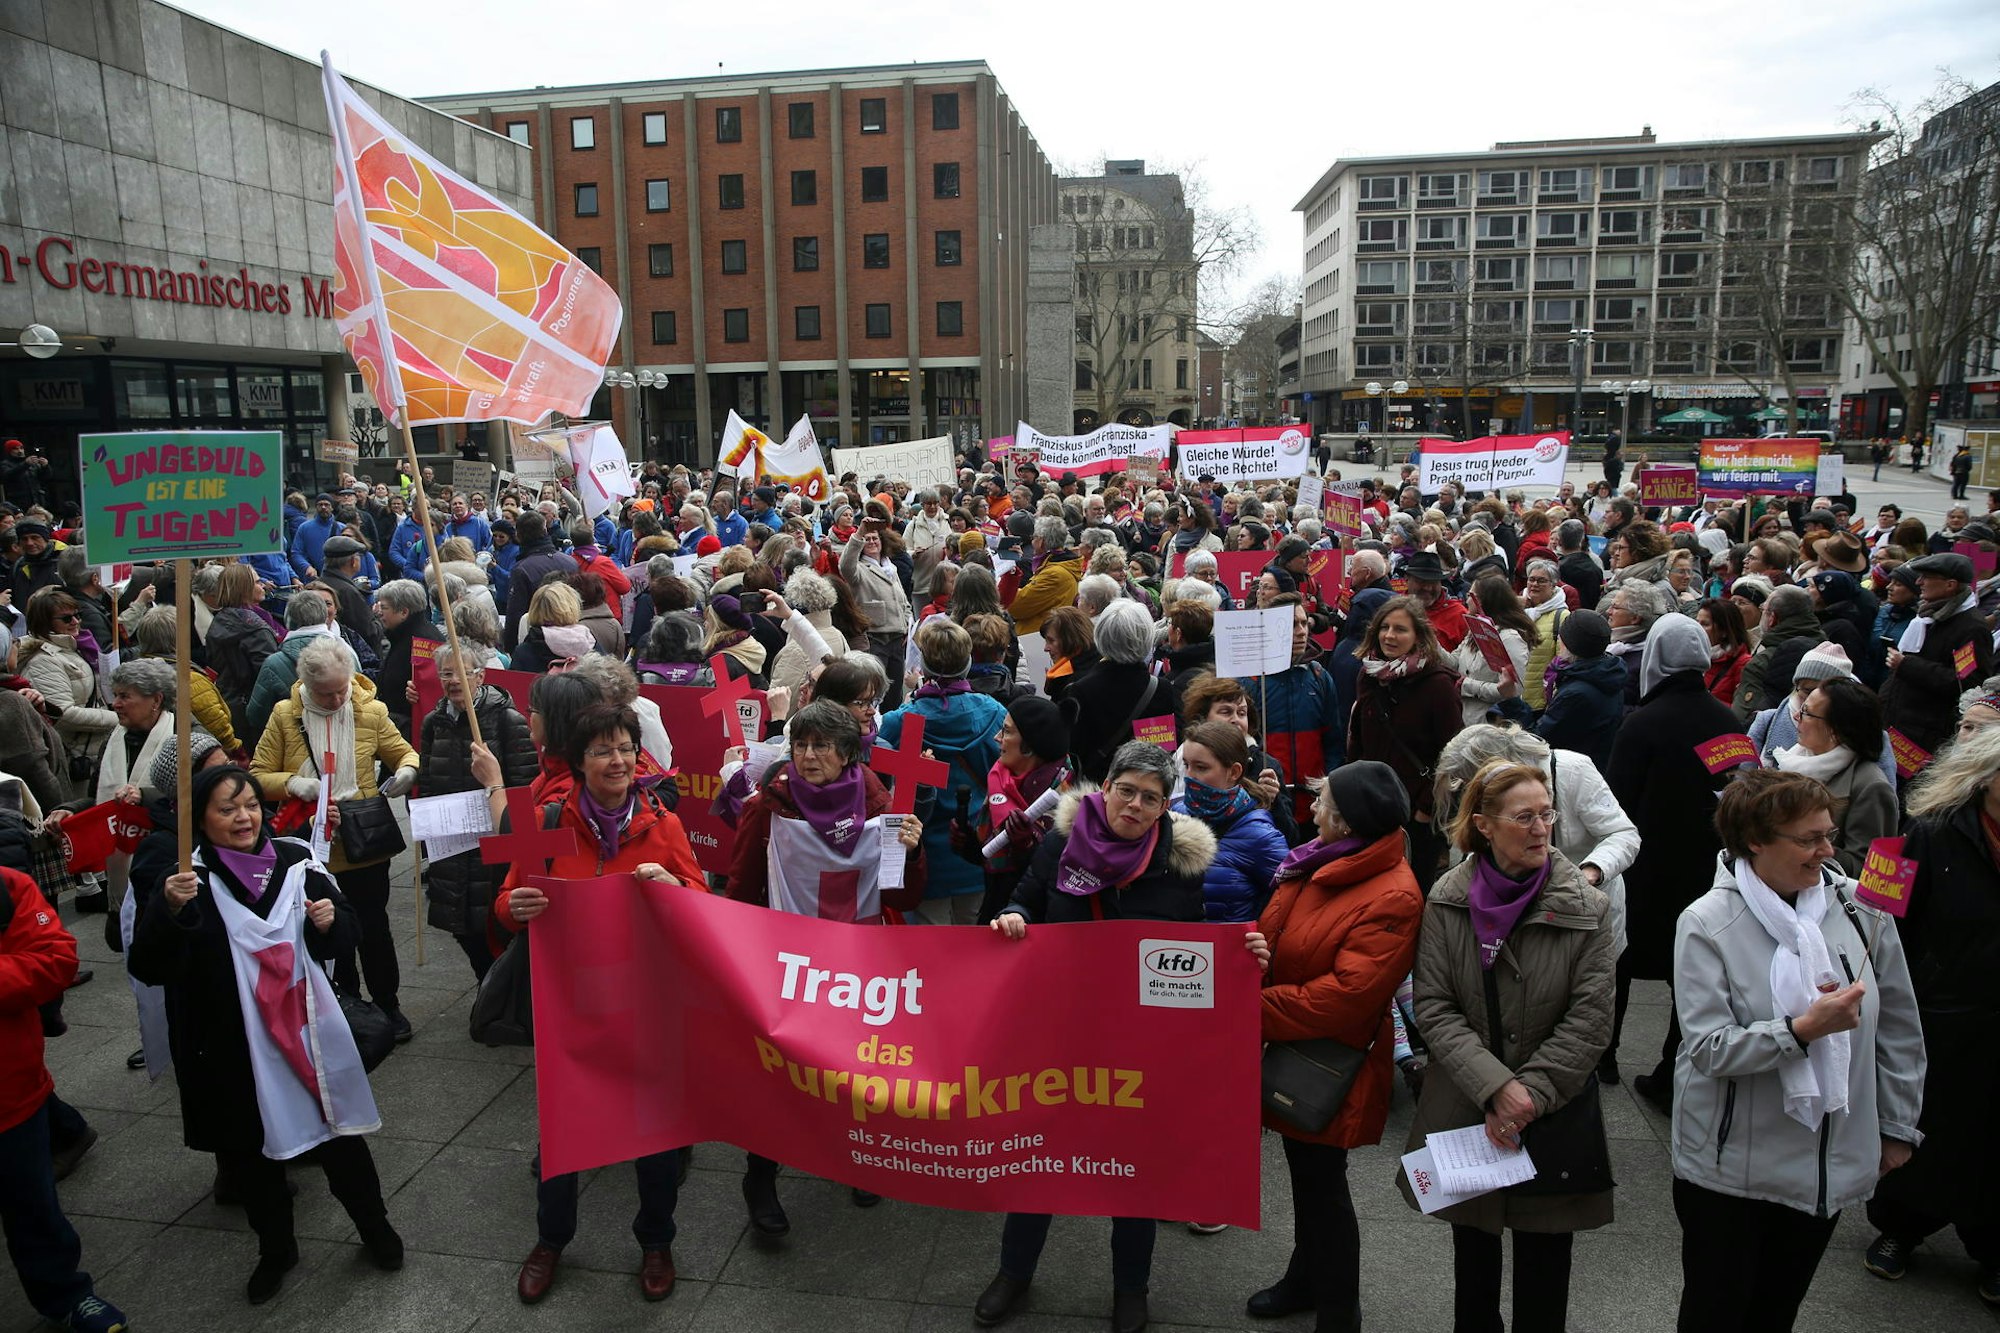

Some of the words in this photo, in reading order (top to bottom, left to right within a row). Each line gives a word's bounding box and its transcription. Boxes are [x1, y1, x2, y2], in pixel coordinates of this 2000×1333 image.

[34, 381, 79, 400] KMT
[249, 385, 279, 401] KMT
[1030, 433, 1083, 451] Franziskus
[1084, 433, 1101, 449] und
[1101, 429, 1148, 442] Franziska
[1040, 451, 1069, 464] beide
[1071, 447, 1107, 464] können
[1107, 444, 1136, 459] Papst!
[1186, 449, 1229, 462] Gleiche
[1231, 446, 1275, 459] Würde!
[105, 443, 266, 487] UNGEDULD
[1188, 463, 1229, 476] Gleiche
[1232, 460, 1278, 474] Rechte!
[1430, 459, 1462, 472] Jesus
[1464, 459, 1488, 472] trug
[1491, 456, 1528, 468] weder
[1429, 472, 1462, 485] Prada
[1465, 471, 1493, 483] noch
[1496, 467, 1536, 481] Purpur.
[1712, 471, 1729, 482] wir
[1729, 469, 1759, 483] feiern
[1760, 470, 1782, 483] mit.
[145, 480, 181, 501] IST
[183, 478, 227, 500] EINE
[1643, 481, 1696, 499] CHANGE
[103, 495, 269, 543] TUGEND!
[1325, 506, 1361, 530] CHANGE
[674, 772, 724, 801] euz
[690, 831, 718, 848] Kirche
[1868, 850, 1897, 876] UND
[1069, 874, 1085, 888] Ihr?
[1157, 953, 1196, 972] kfd
[776, 951, 923, 1026] Tragt
[1149, 979, 1165, 988] die
[1168, 981, 1205, 991] macht.
[1160, 990, 1177, 998] dich.
[1178, 989, 1189, 998] für
[1190, 991, 1205, 999] alle.
[856, 1034, 914, 1067] das
[754, 1034, 1144, 1122] Purpurkreuz
[848, 1127, 874, 1148] als
[880, 1133, 959, 1157] Zeichen
[965, 1139, 995, 1157] für
[1001, 1132, 1044, 1152] eine
[851, 1147, 1064, 1184] geschlechtergerechte
[1071, 1154, 1136, 1178] Kirche
[1413, 1168, 1428, 1195] MARIA
[1421, 1171, 1432, 1187] 2.0
